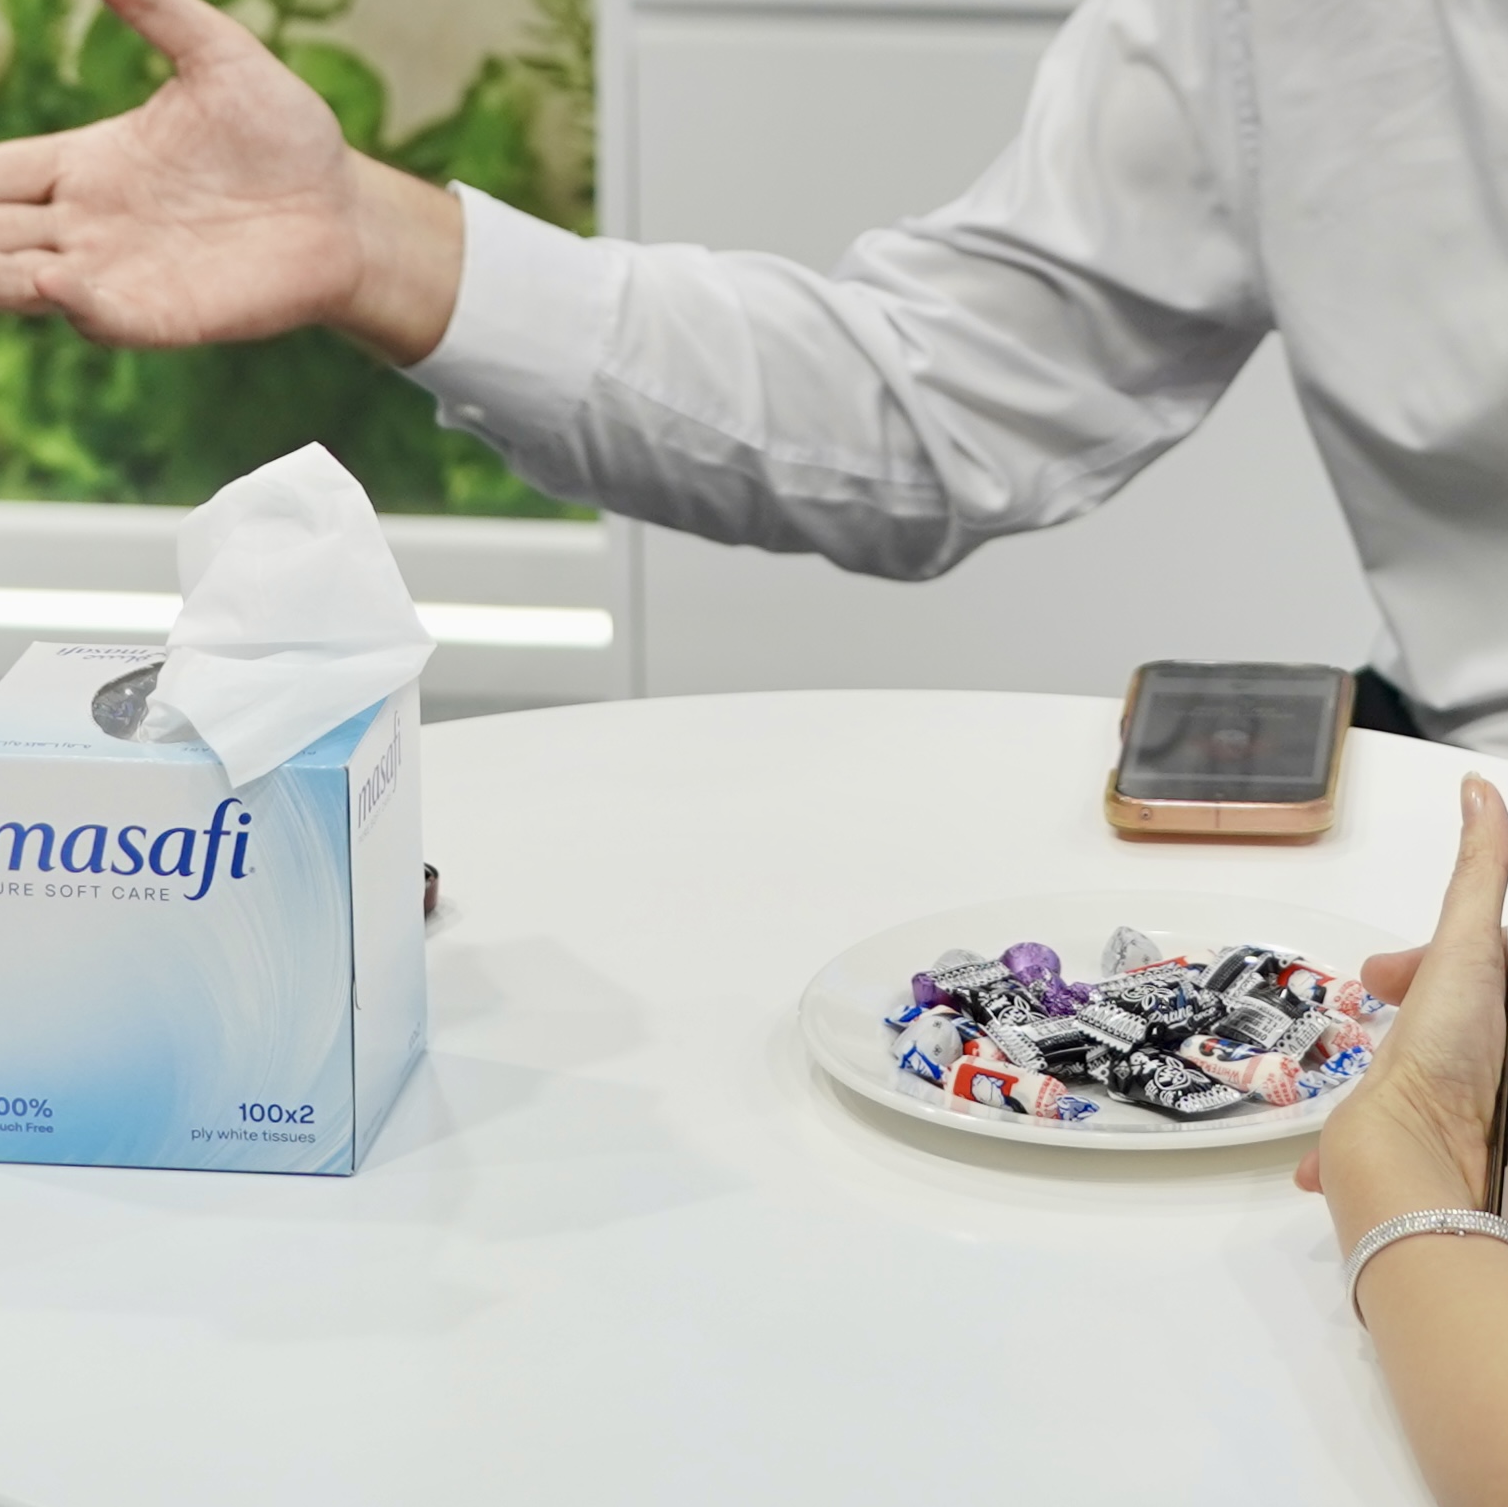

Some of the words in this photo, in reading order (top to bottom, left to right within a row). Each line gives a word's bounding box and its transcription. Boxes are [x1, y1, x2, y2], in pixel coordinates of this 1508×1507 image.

[45, 884, 102, 898] SOFT
[111, 886, 170, 901] CARE
[239, 1103, 315, 1124] 100x2
[26, 1121, 54, 1134] Free
[192, 1127, 214, 1141] ply
[218, 1128, 258, 1142] white
[262, 1129, 316, 1144] tissues
